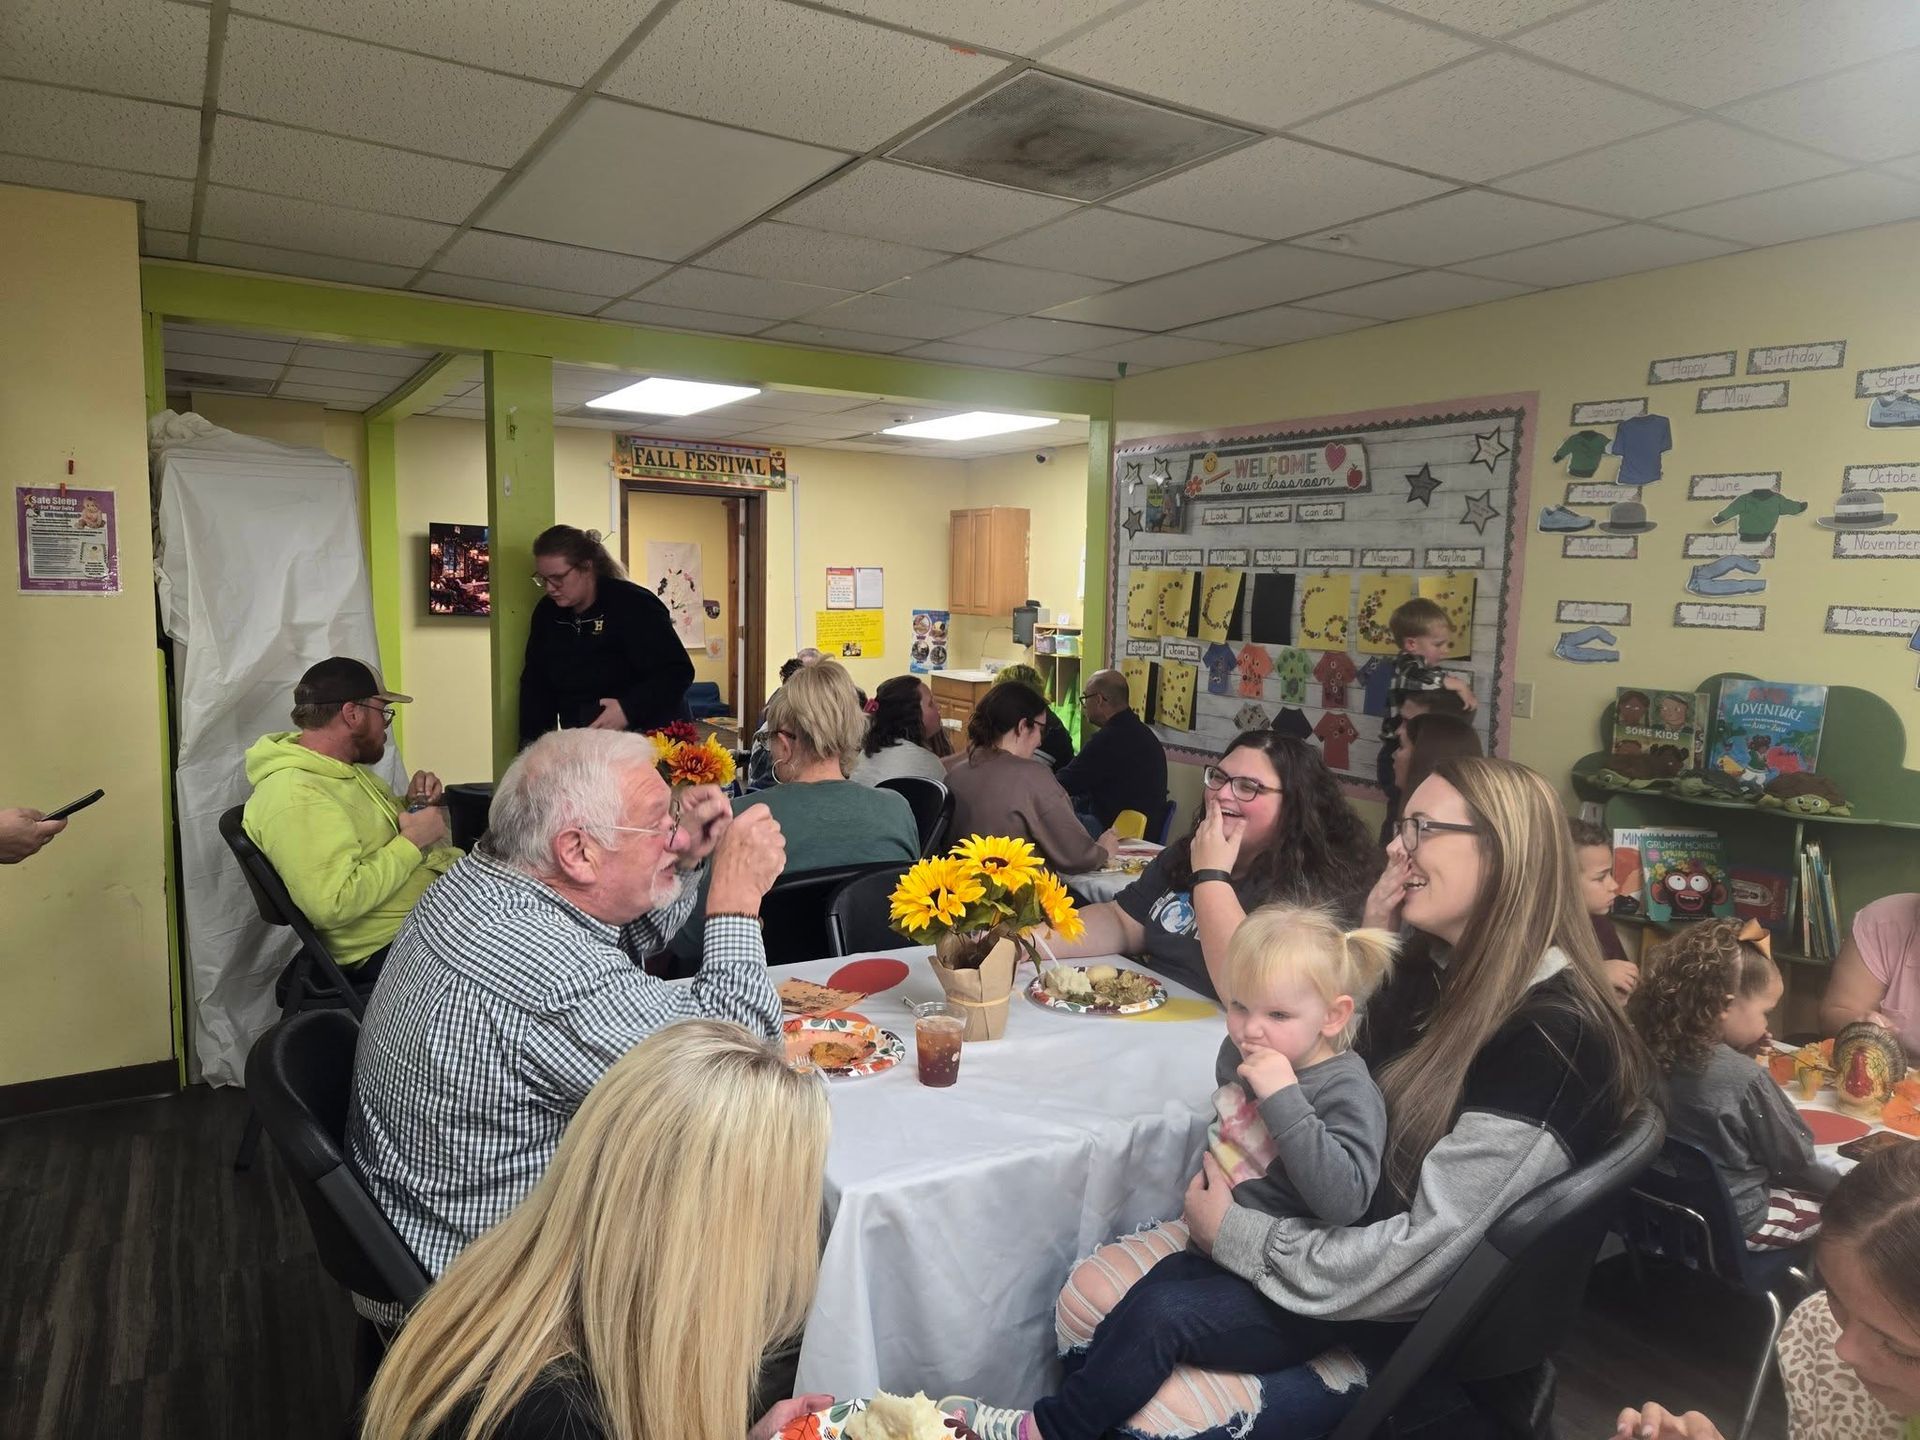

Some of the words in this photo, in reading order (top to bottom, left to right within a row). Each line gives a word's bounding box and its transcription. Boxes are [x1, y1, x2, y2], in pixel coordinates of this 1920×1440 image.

[1671, 361, 1706, 377] Happy
[1764, 349, 1823, 366] Birthday
[1724, 388, 1751, 405] May
[633, 446, 680, 468] FALL
[685, 451, 766, 476] FESTIVAL
[1234, 452, 1317, 479] WELCOME
[1220, 480, 1233, 493] to
[1236, 479, 1259, 492] our
[1261, 474, 1336, 492] classroom
[1868, 467, 1920, 484] Octobe
[1710, 478, 1742, 492] June
[31, 496, 51, 505] Safe
[52, 496, 77, 506] Sleep
[1210, 510, 1228, 521] Look
[1255, 508, 1271, 519] what
[1304, 509, 1319, 518] can
[1579, 538, 1612, 552] March
[1706, 535, 1738, 554] July
[1853, 533, 1920, 551] November
[1695, 606, 1739, 625] August
[1844, 608, 1919, 628] December
[1732, 702, 1806, 722] ADVENTURE
[1625, 726, 1653, 738] SOME
[1655, 730, 1680, 740] KIDS
[1645, 840, 1682, 850] GRUMPY
[1685, 841, 1721, 851] MONKEY
